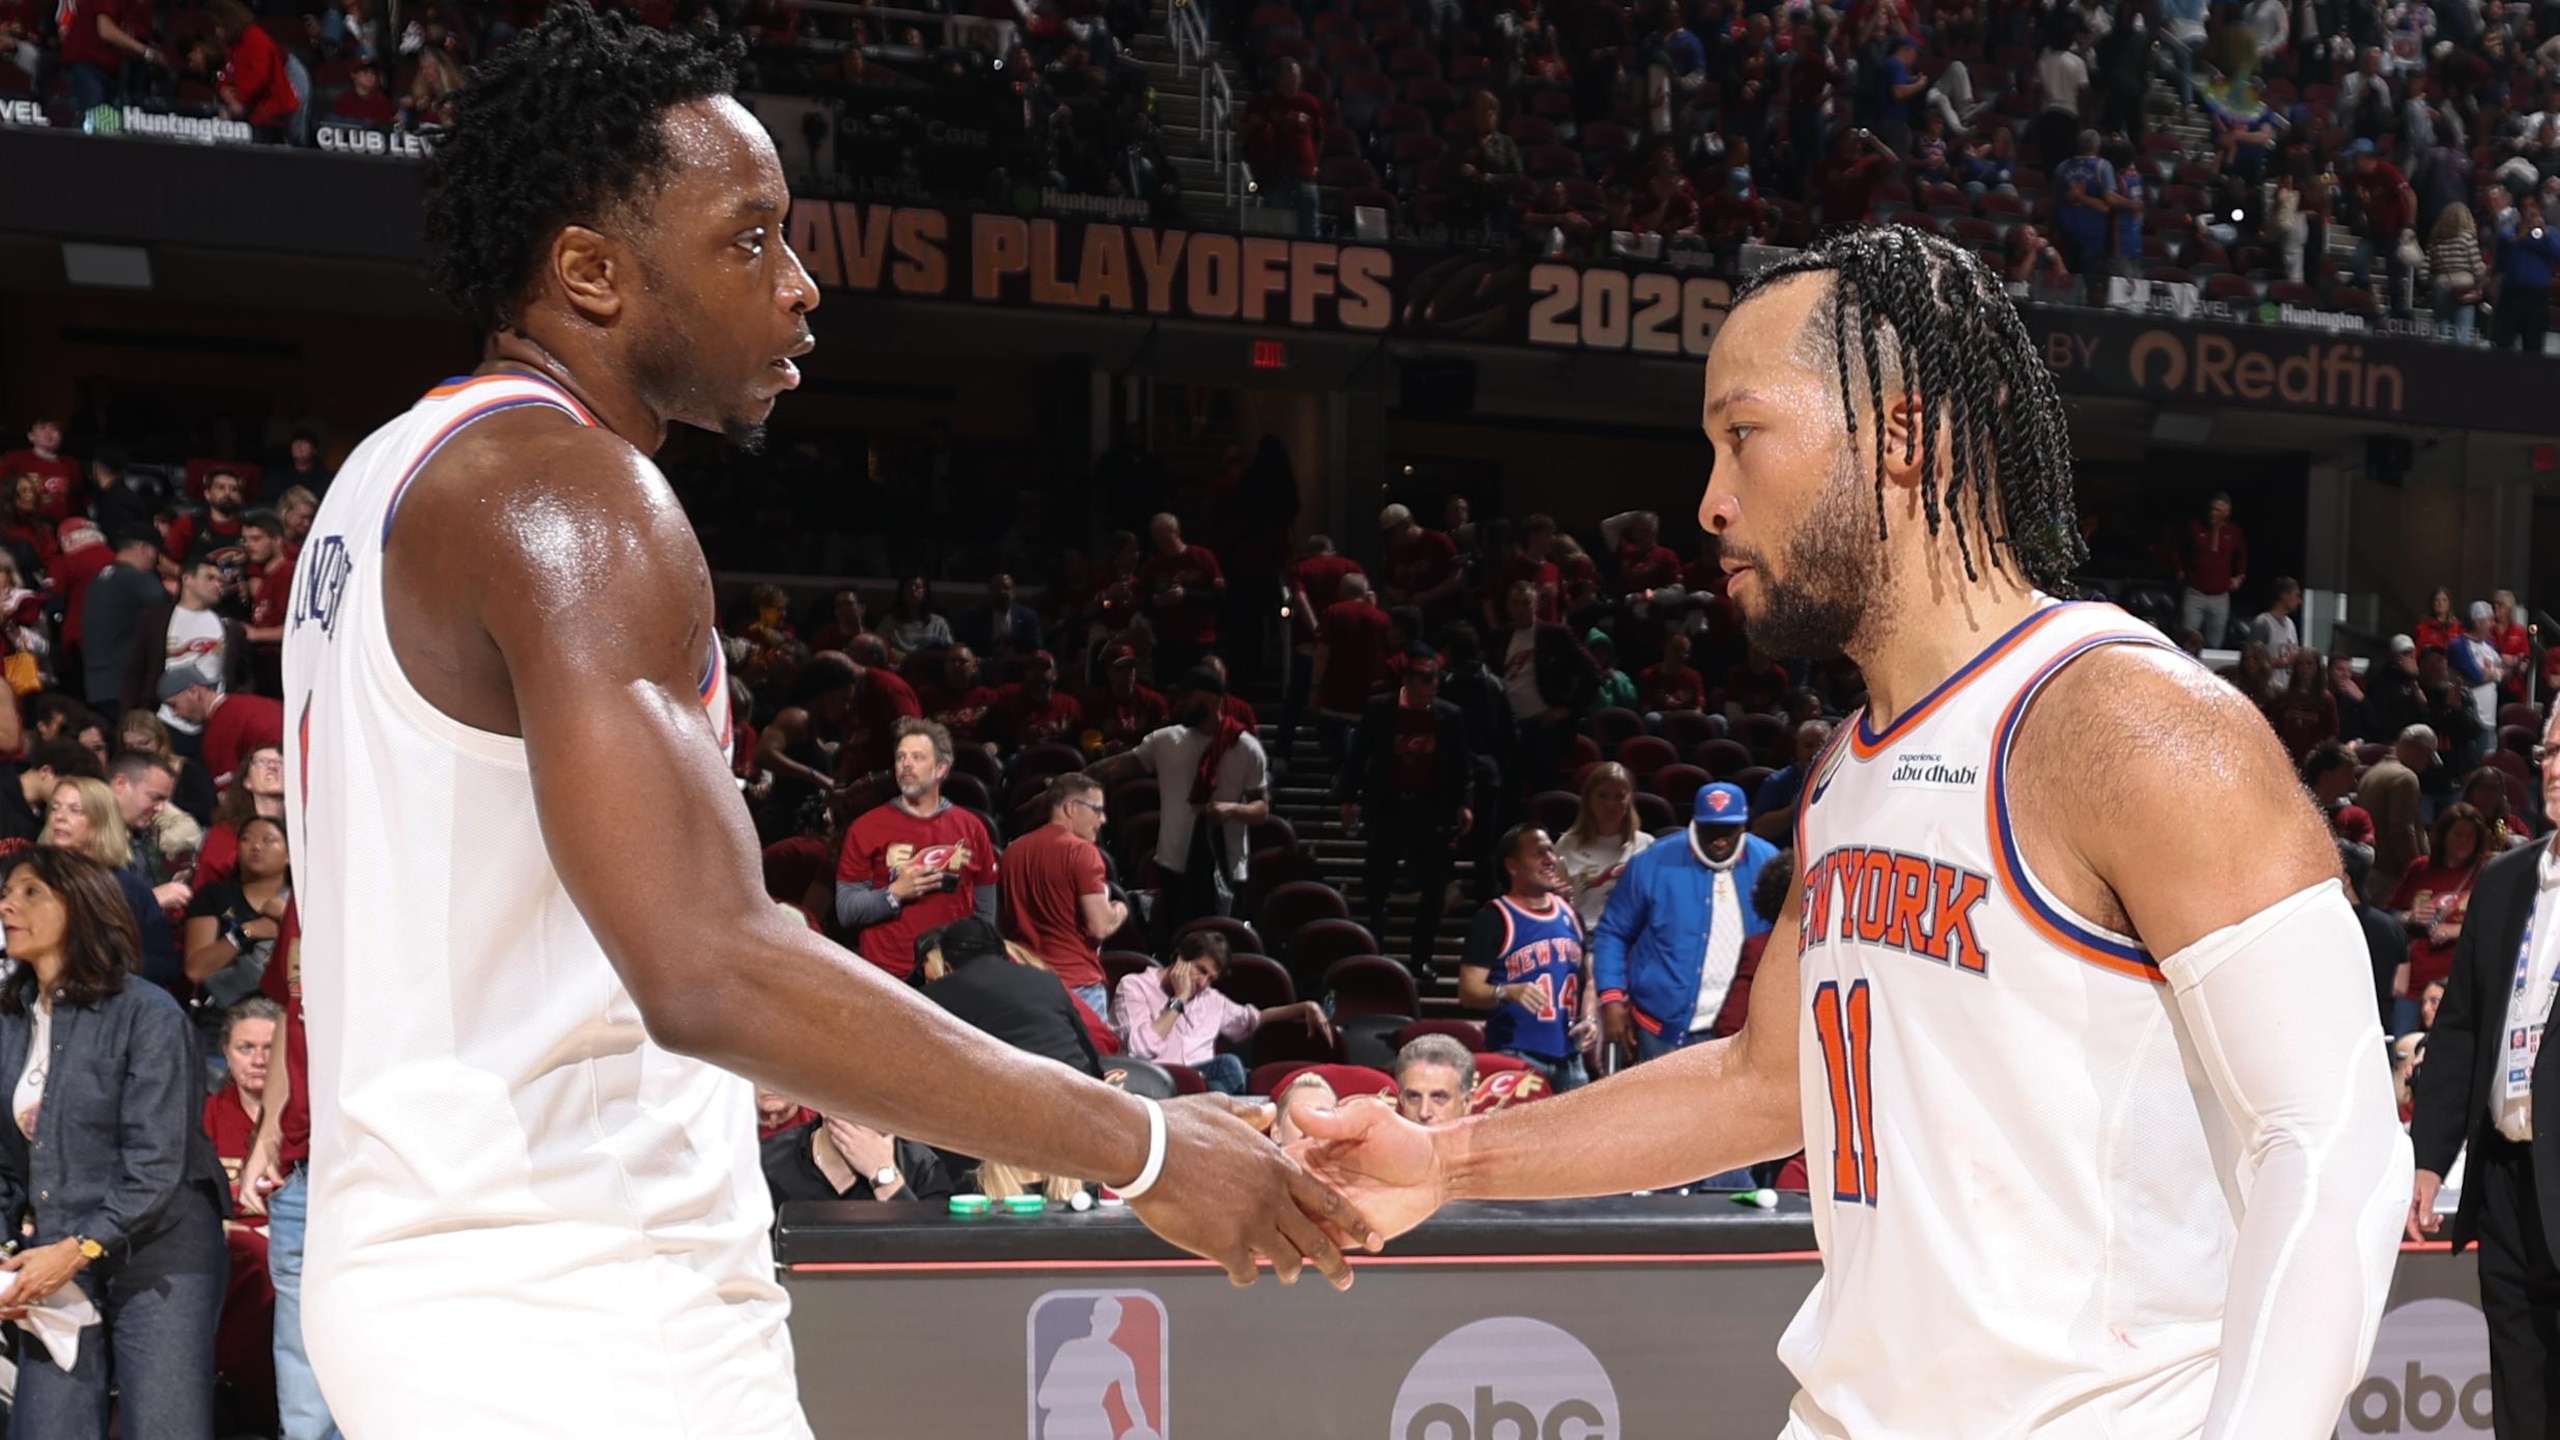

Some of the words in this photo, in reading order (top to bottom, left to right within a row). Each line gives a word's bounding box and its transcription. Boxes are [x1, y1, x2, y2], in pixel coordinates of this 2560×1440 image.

[0, 99, 49, 127] VEL
[122, 105, 252, 146] Huntington
[317, 127, 384, 154] CLUB
[390, 132, 435, 158] LEV
[1041, 186, 1149, 219] Huntington
[790, 198, 949, 295] AVS
[972, 213, 1392, 331] PLAYOFFS
[1529, 263, 1733, 356] 2026
[2281, 302, 2365, 333] Huntington
[2046, 331, 2100, 371] BY
[2195, 333, 2405, 411] Redfin
[1892, 763, 1923, 781] abu
[1925, 764, 1979, 785] dhabi
[1898, 753, 1942, 763] experience
[1836, 843, 1992, 980] YORK
[1504, 939, 1551, 981] NEW
[1534, 972, 1578, 1022] 14
[1812, 979, 1878, 1209] 11
[2349, 1360, 2494, 1436] abc
